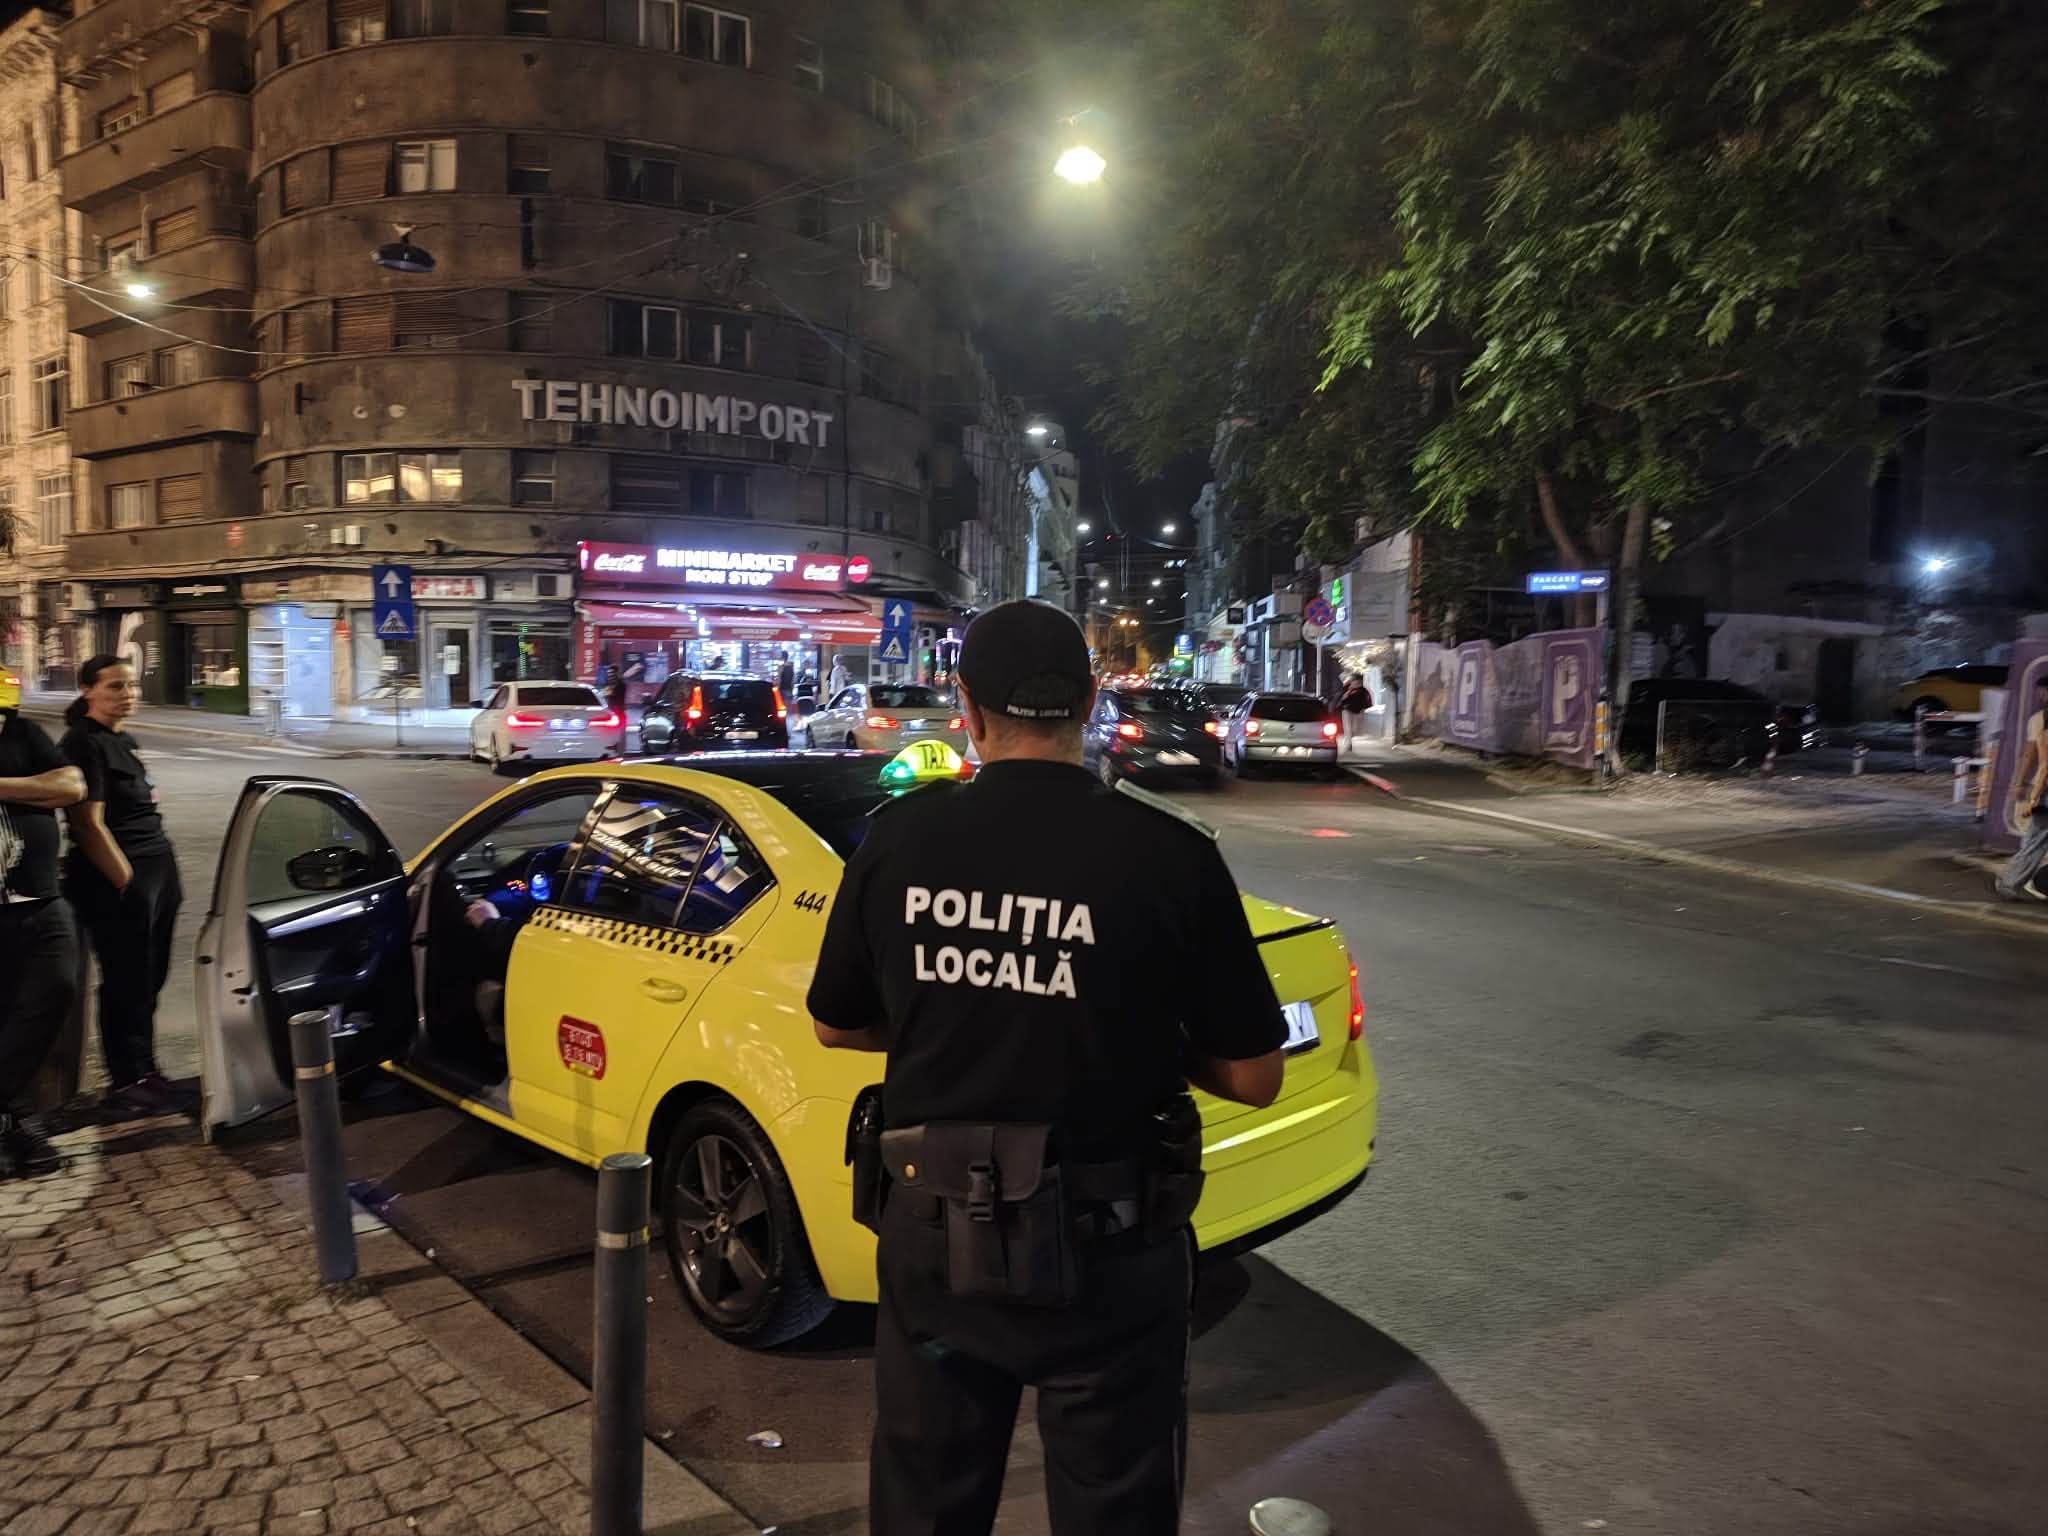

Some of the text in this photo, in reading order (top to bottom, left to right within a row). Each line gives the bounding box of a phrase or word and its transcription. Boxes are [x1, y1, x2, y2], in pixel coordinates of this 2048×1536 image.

[511, 379, 833, 448] TEHNOIMPORT
[657, 549, 797, 572] MINIMARKET
[686, 569, 773, 586] NON STOP
[793, 890, 828, 915] 444
[905, 886, 1096, 946] POLIȚIA
[914, 943, 1077, 999] LOCALĂ
